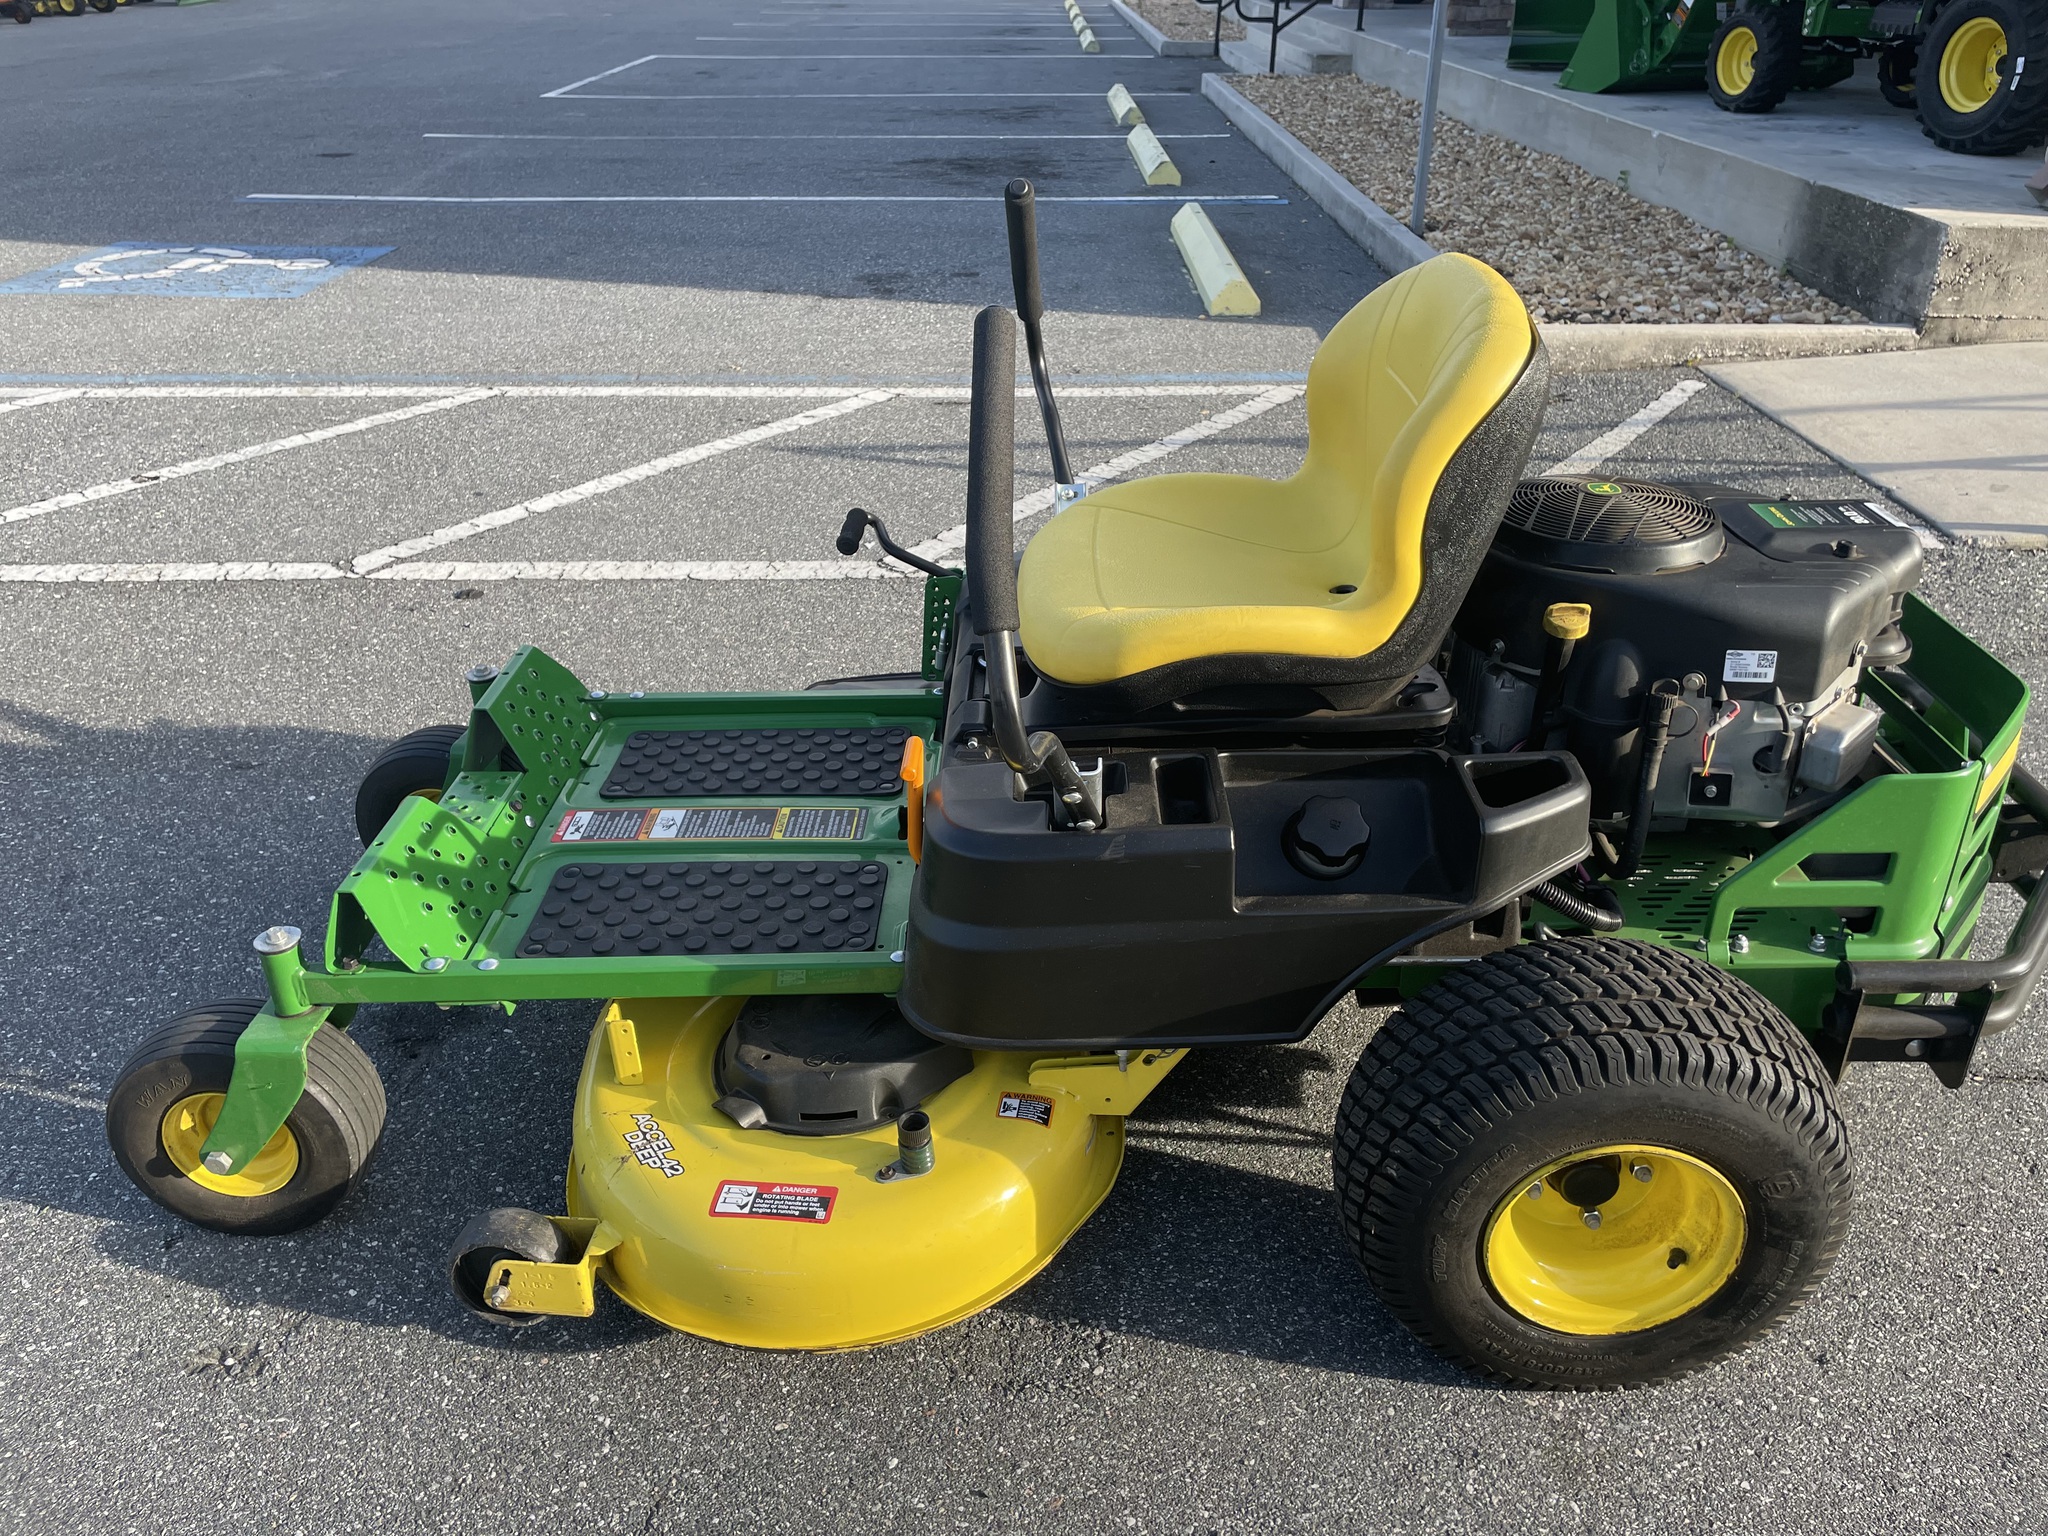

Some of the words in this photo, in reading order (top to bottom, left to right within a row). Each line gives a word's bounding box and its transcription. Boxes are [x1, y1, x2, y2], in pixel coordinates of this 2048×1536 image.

[1014, 1093, 1052, 1103] WARNING
[622, 1130, 662, 1169] DEEP
[782, 1186, 818, 1194] DANGER
[1432, 1233, 1448, 1284] TURF
[1442, 1143, 1519, 1221] MASTER
